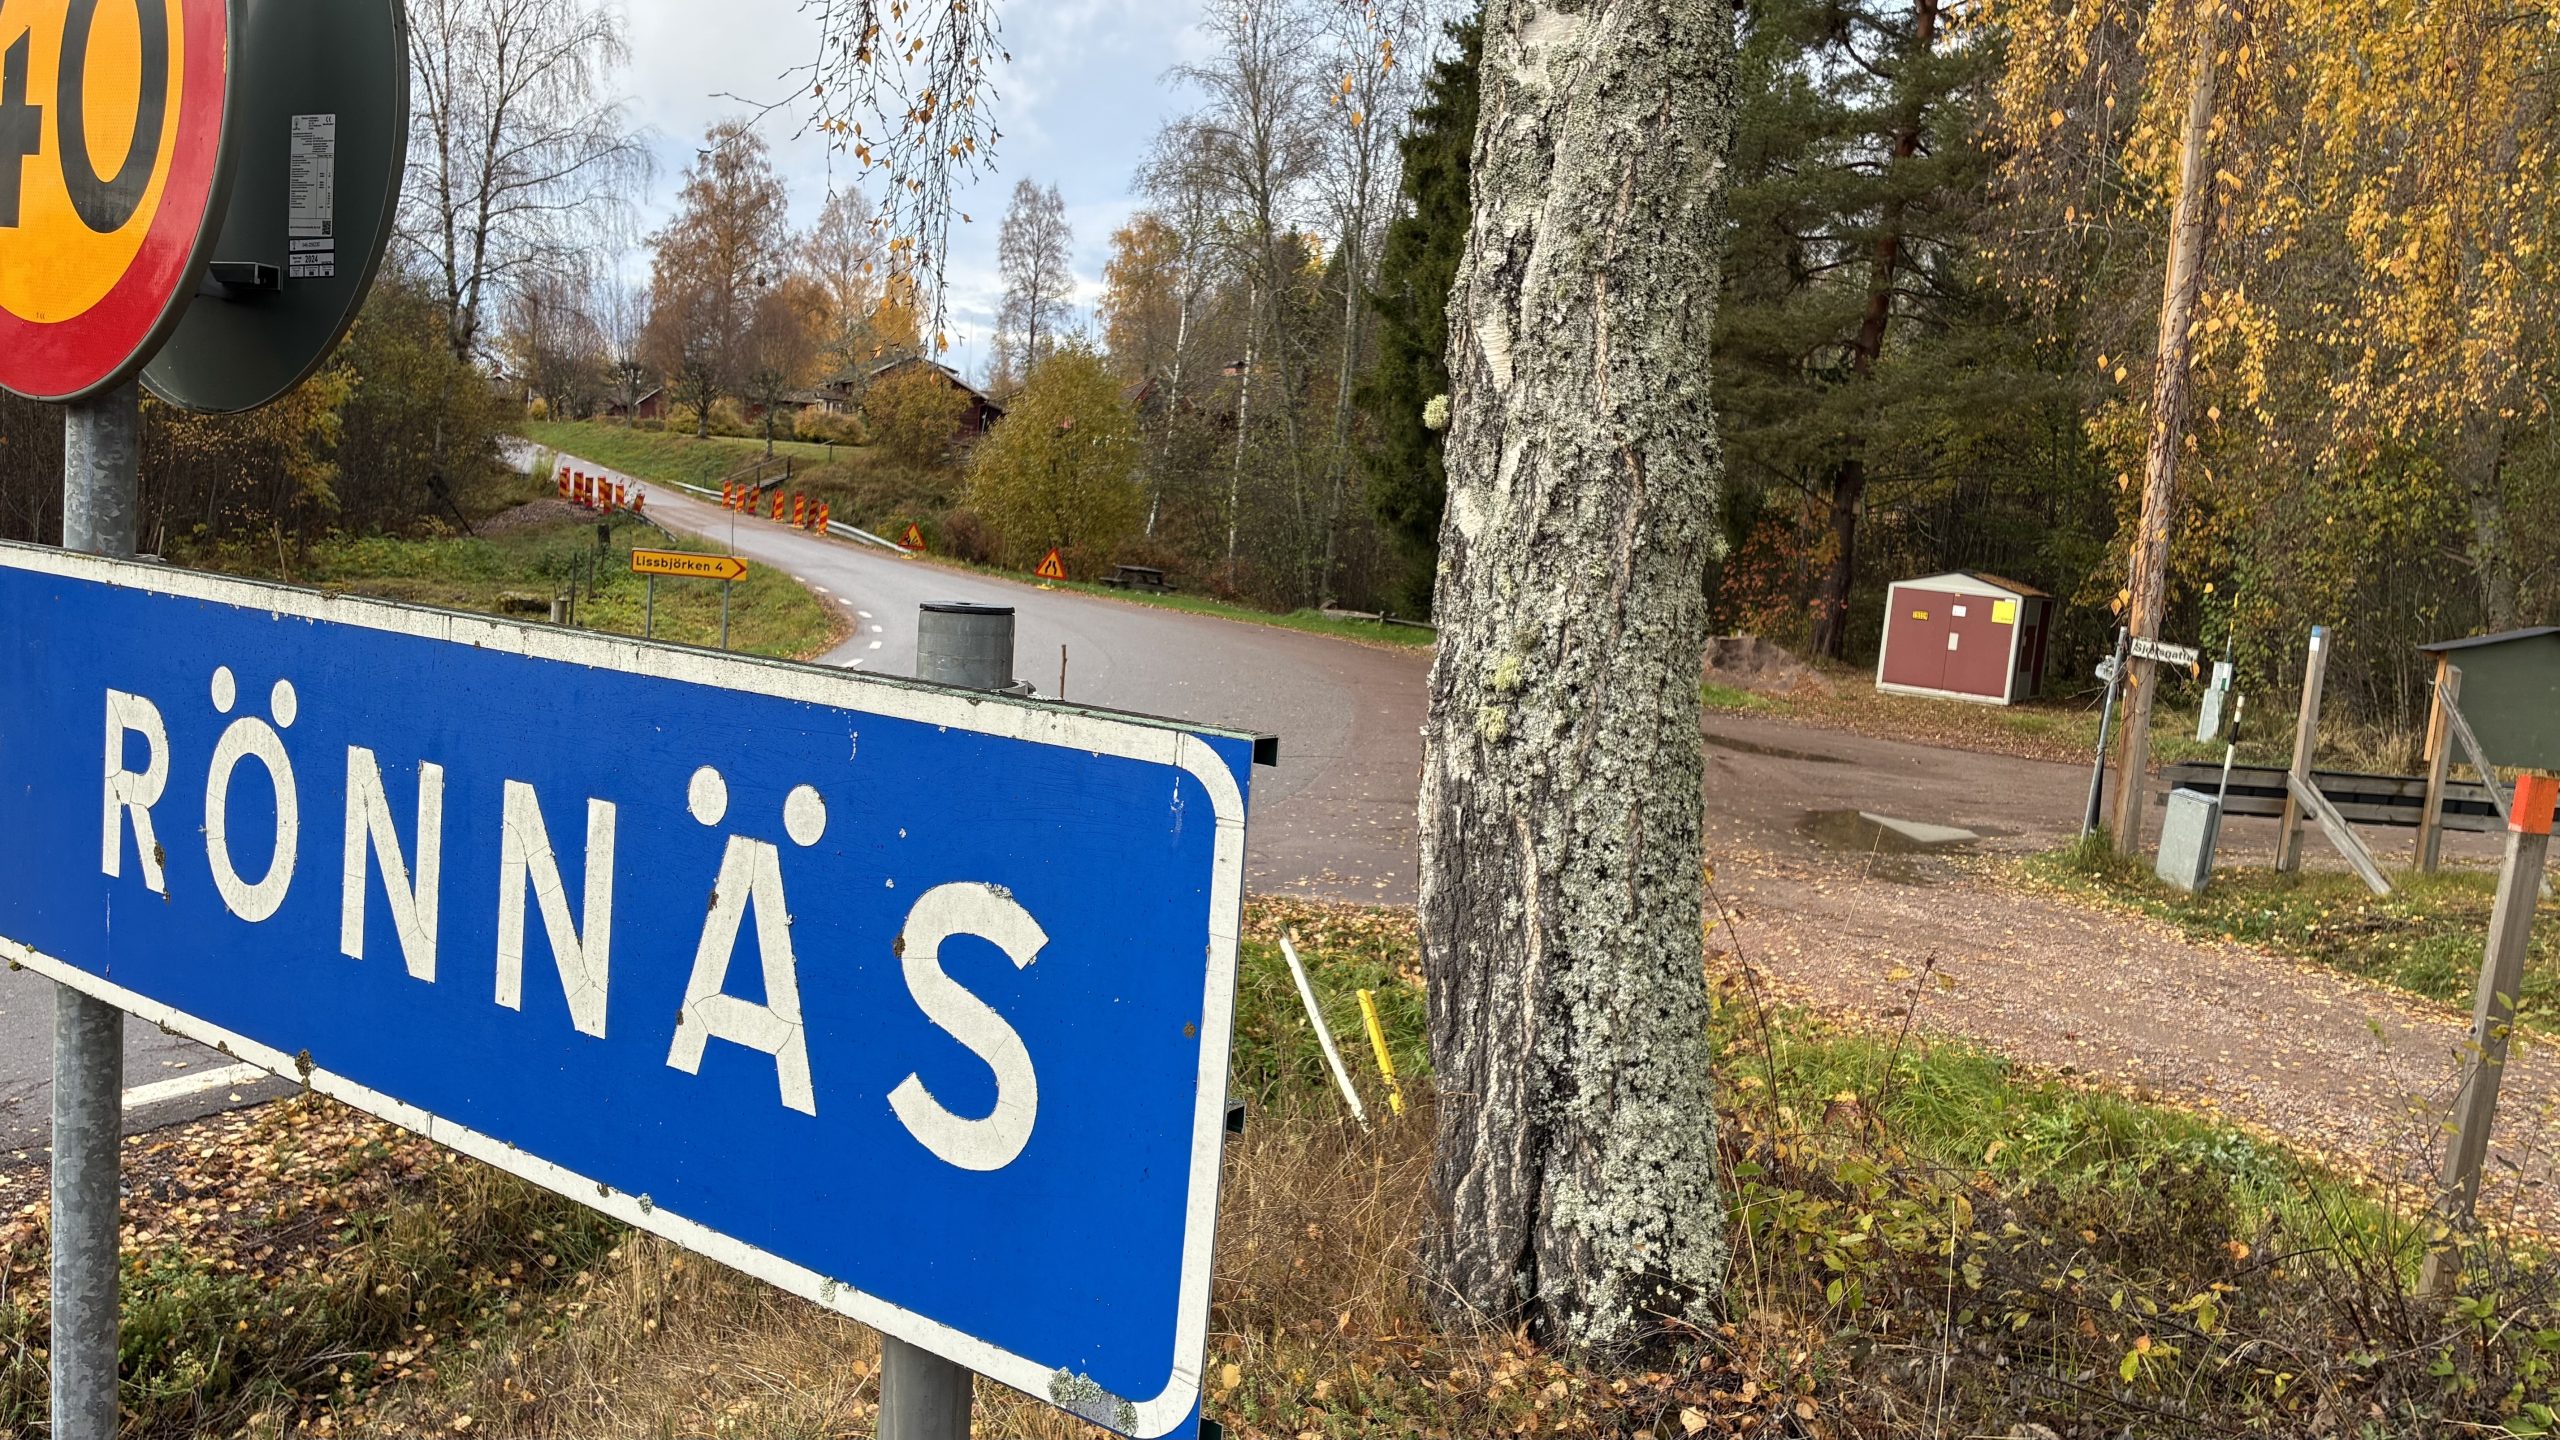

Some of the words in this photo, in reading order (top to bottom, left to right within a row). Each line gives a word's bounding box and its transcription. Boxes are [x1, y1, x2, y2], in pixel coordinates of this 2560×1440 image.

[0, 0, 168, 233] 40
[305, 254, 319, 263] 2024
[636, 556, 710, 571] Lissbjörken
[715, 562, 724, 572] 4
[101, 665, 1050, 1171] RÖNNÄS
